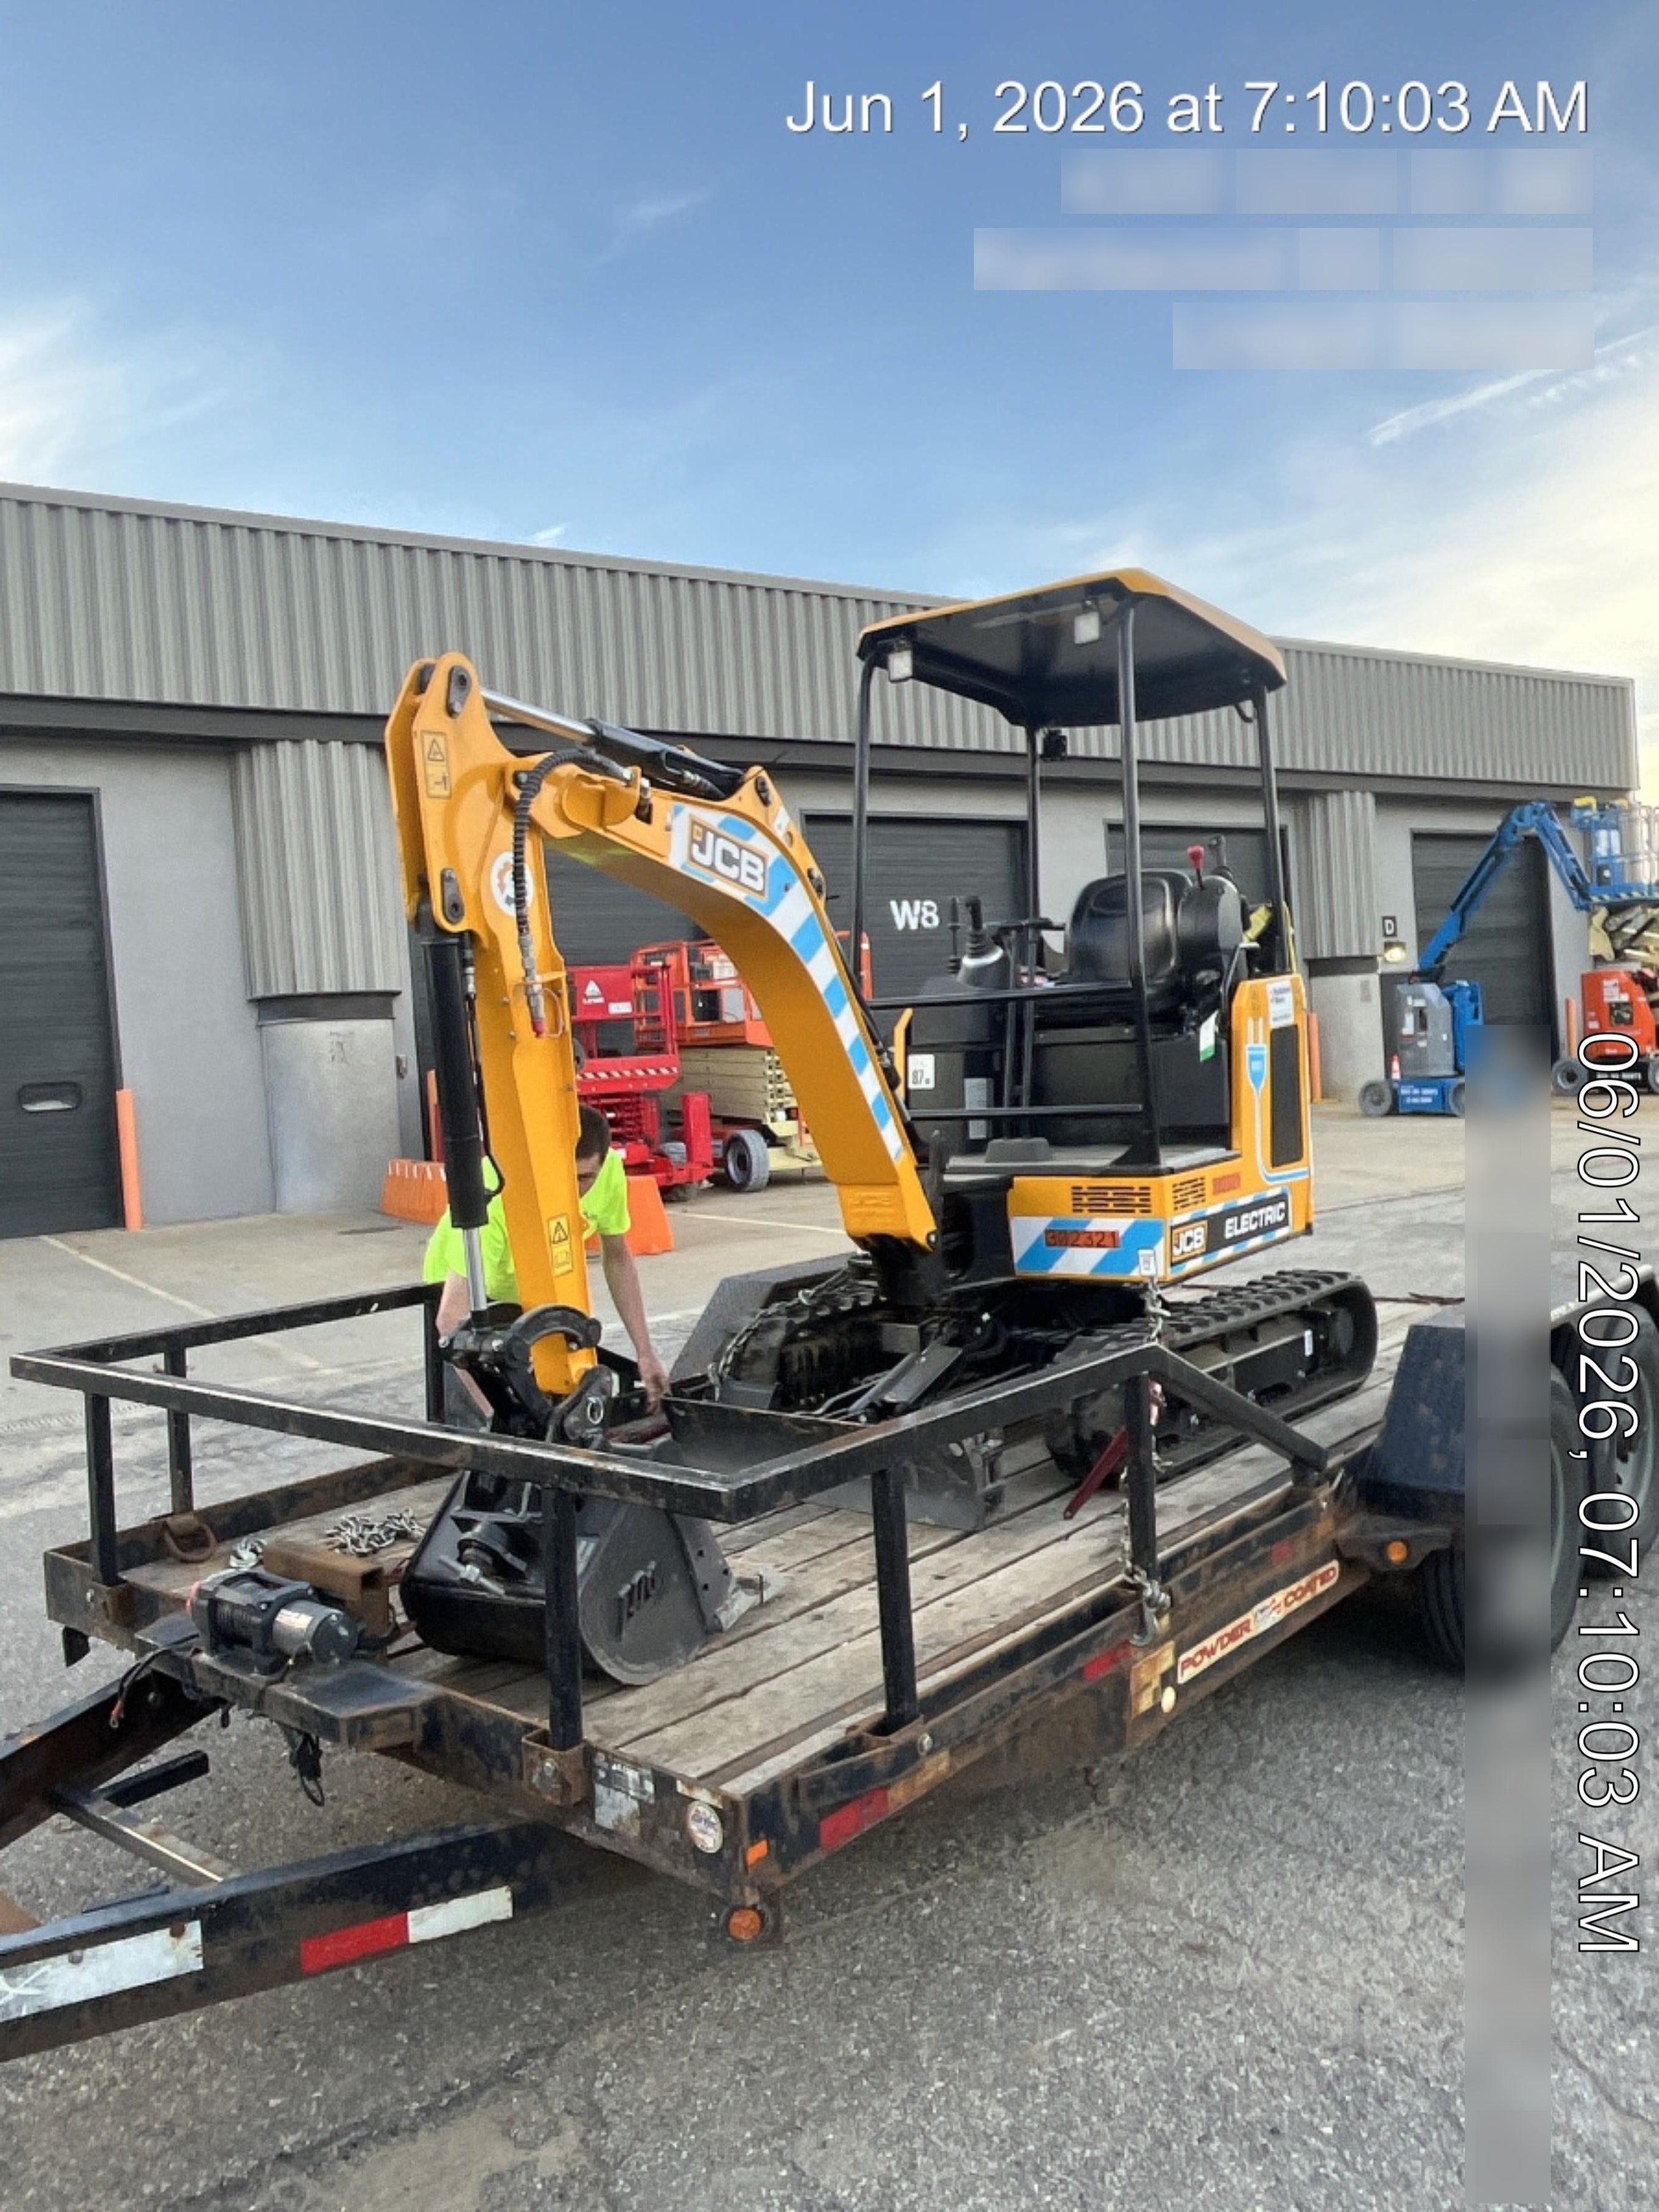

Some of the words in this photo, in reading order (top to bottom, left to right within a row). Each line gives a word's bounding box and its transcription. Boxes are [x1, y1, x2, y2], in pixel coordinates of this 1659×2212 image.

[692, 830, 764, 892] JCB
[890, 900, 939, 931] W8
[1172, 1227, 1205, 1255] JCB
[1225, 1202, 1285, 1239] ELECTRIC
[1181, 1618, 1252, 1677] POWDER
[1284, 1566, 1336, 1608] COATED
